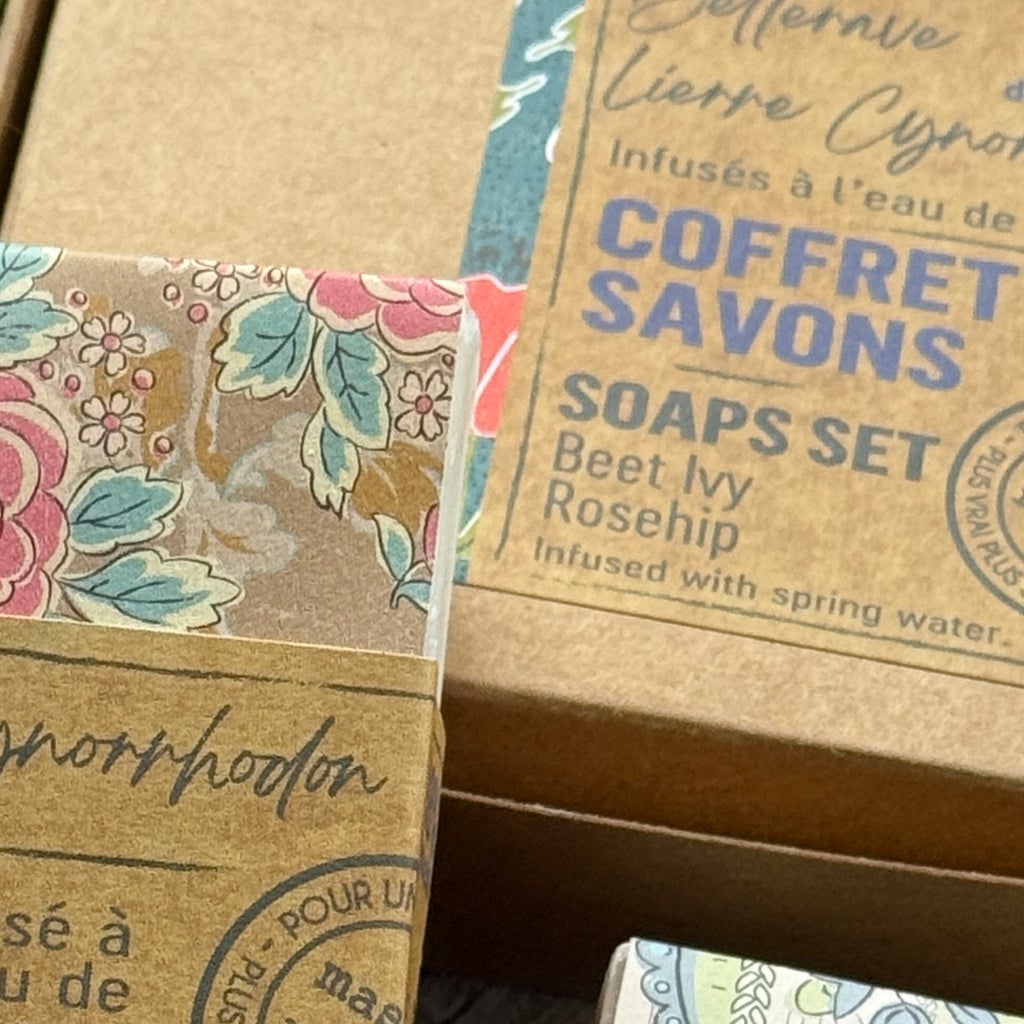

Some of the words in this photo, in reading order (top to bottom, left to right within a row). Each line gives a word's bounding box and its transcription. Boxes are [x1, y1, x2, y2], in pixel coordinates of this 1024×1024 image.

[603, 43, 813, 120] Lierre
[610, 139, 770, 191] Infusés
[790, 169, 814, 200] à
[833, 177, 944, 222] l'eau
[962, 200, 1016, 234] de
[596, 197, 1019, 322] COFFRET
[580, 270, 965, 391] SAVONS
[557, 372, 792, 457] SOAPS
[808, 416, 941, 482] SET
[552, 430, 666, 490] Beet
[682, 454, 754, 512] Ivy
[543, 478, 742, 561] Rosehip
[534, 536, 668, 583] Infused
[680, 565, 758, 600] with
[771, 585, 881, 628] spring
[897, 608, 1012, 648] water.
[98, 905, 132, 958] à
[278, 879, 373, 940] POUR
[57, 961, 131, 1013] de
